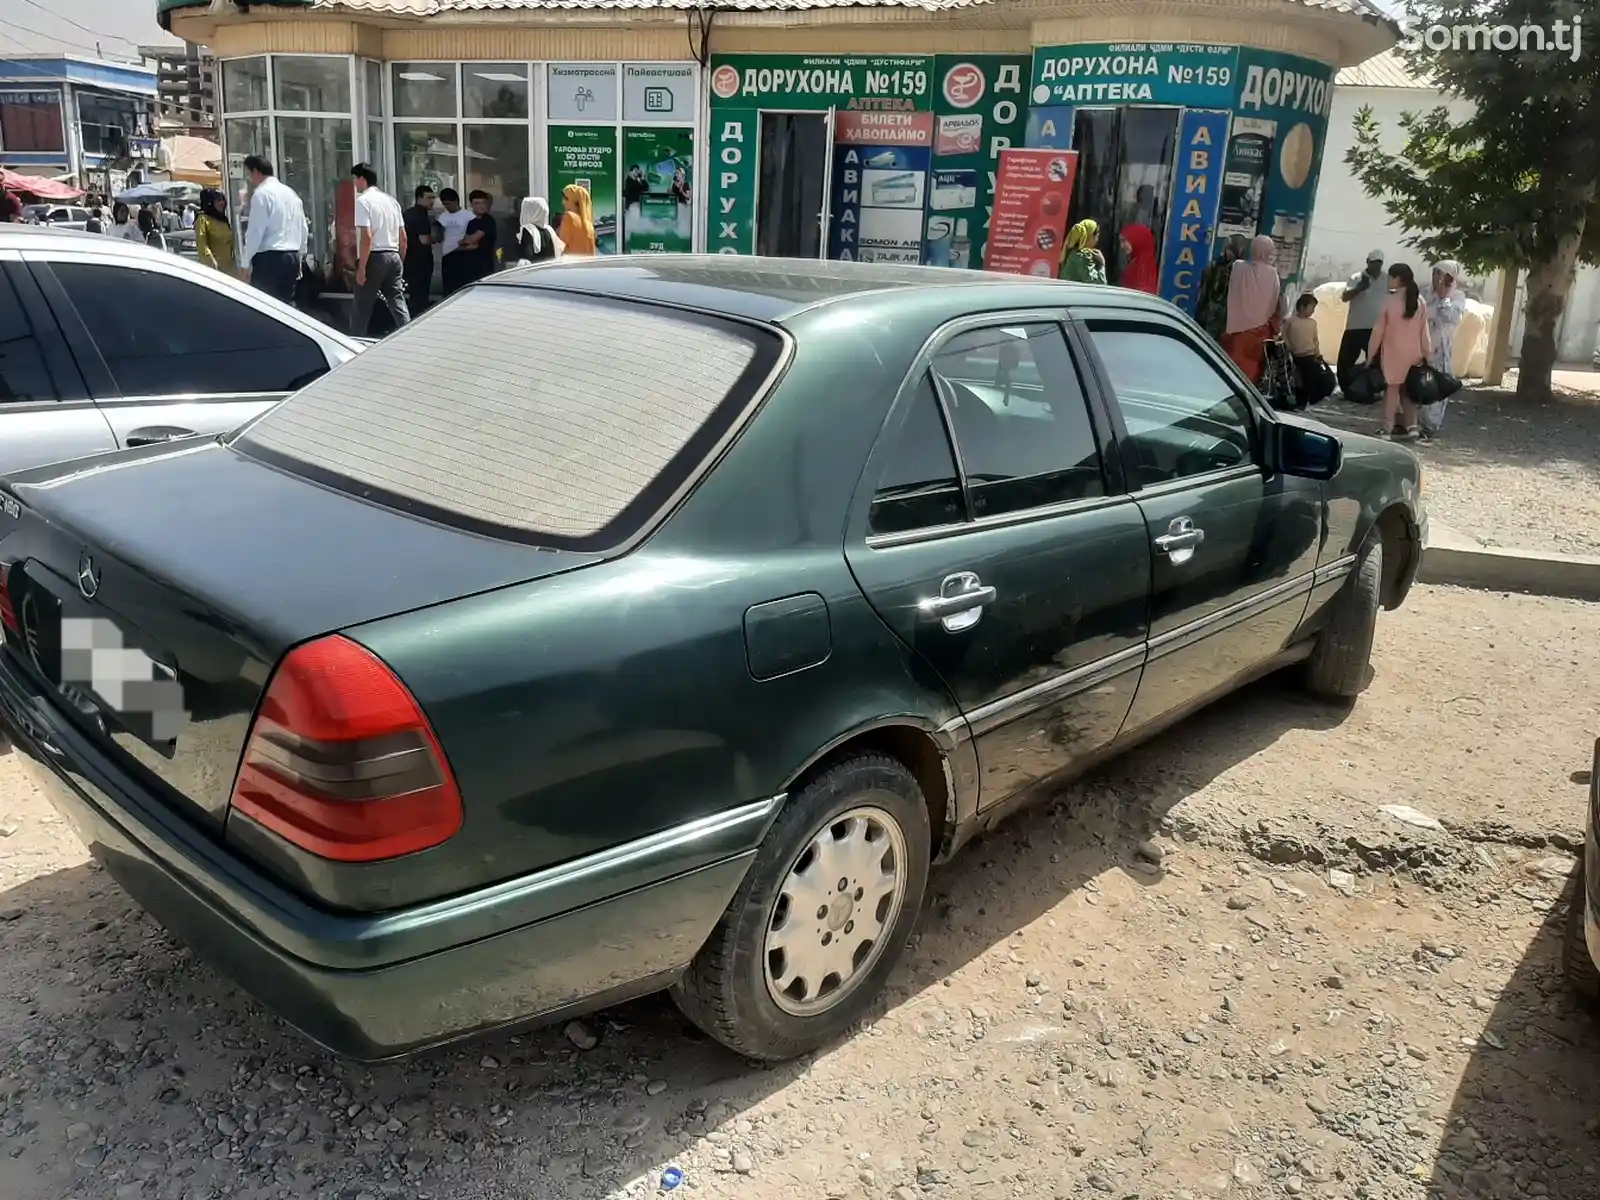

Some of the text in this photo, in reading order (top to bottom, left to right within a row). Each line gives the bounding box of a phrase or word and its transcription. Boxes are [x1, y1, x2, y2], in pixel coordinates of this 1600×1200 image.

[1041, 56, 1231, 87] ДОРУХОНА №159
[742, 68, 927, 97] ДОРУХОНА №159
[846, 97, 916, 111] АПТЕКА
[861, 114, 912, 126] БИЛЕТИ
[859, 238, 898, 246] SOMON
[877, 252, 919, 262] TAJIK AIR
